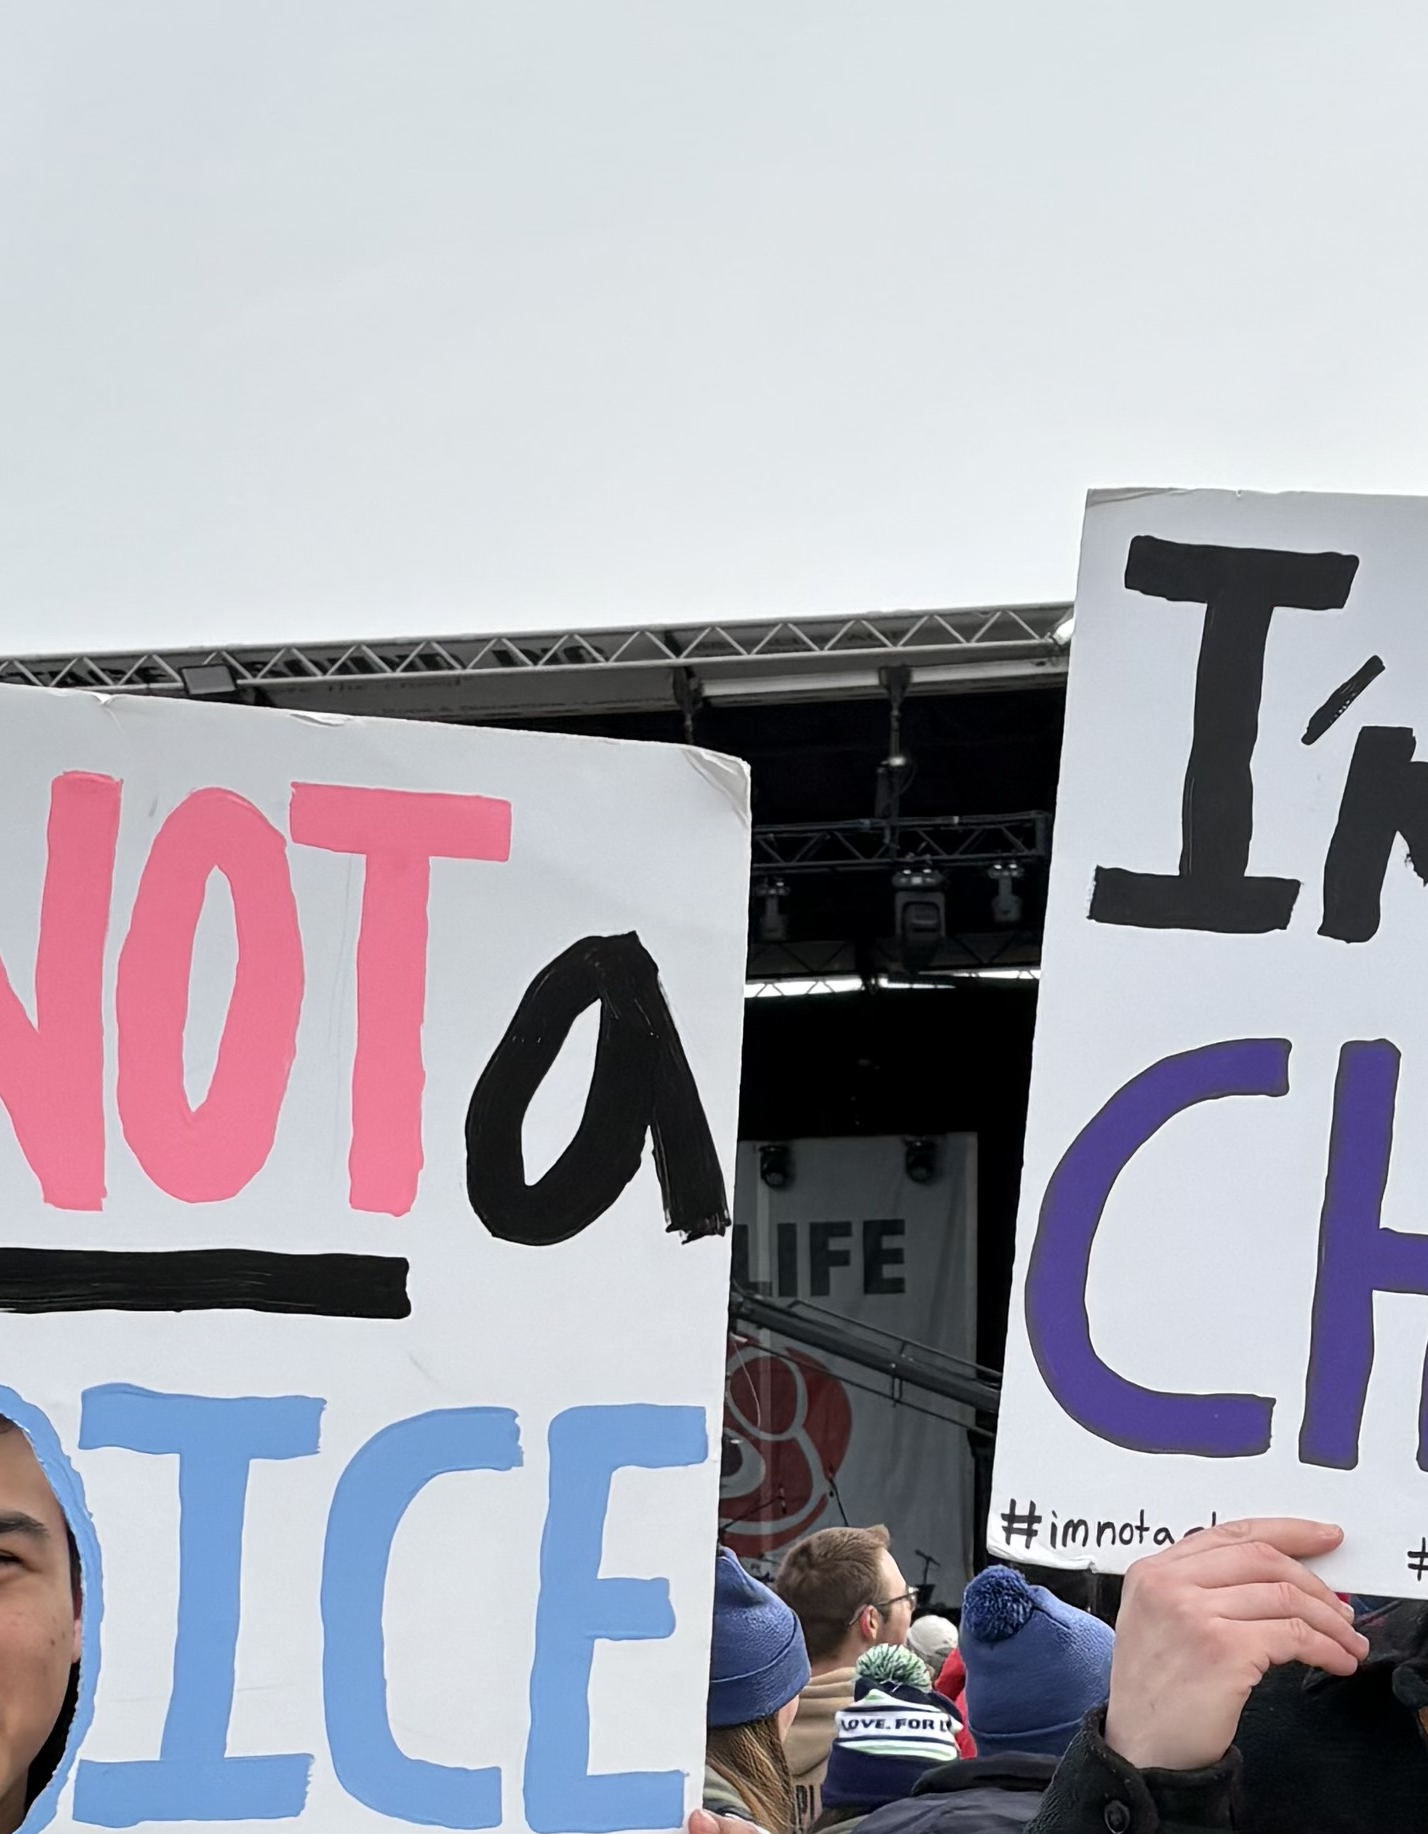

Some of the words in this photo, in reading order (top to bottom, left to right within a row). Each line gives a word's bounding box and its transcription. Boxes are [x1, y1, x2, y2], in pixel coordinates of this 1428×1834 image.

[465, 931, 732, 1244] a
[733, 1218, 906, 1298] LIFE
[1001, 1498, 1218, 1550] #imnota
[895, 1718, 935, 1730] FOR
